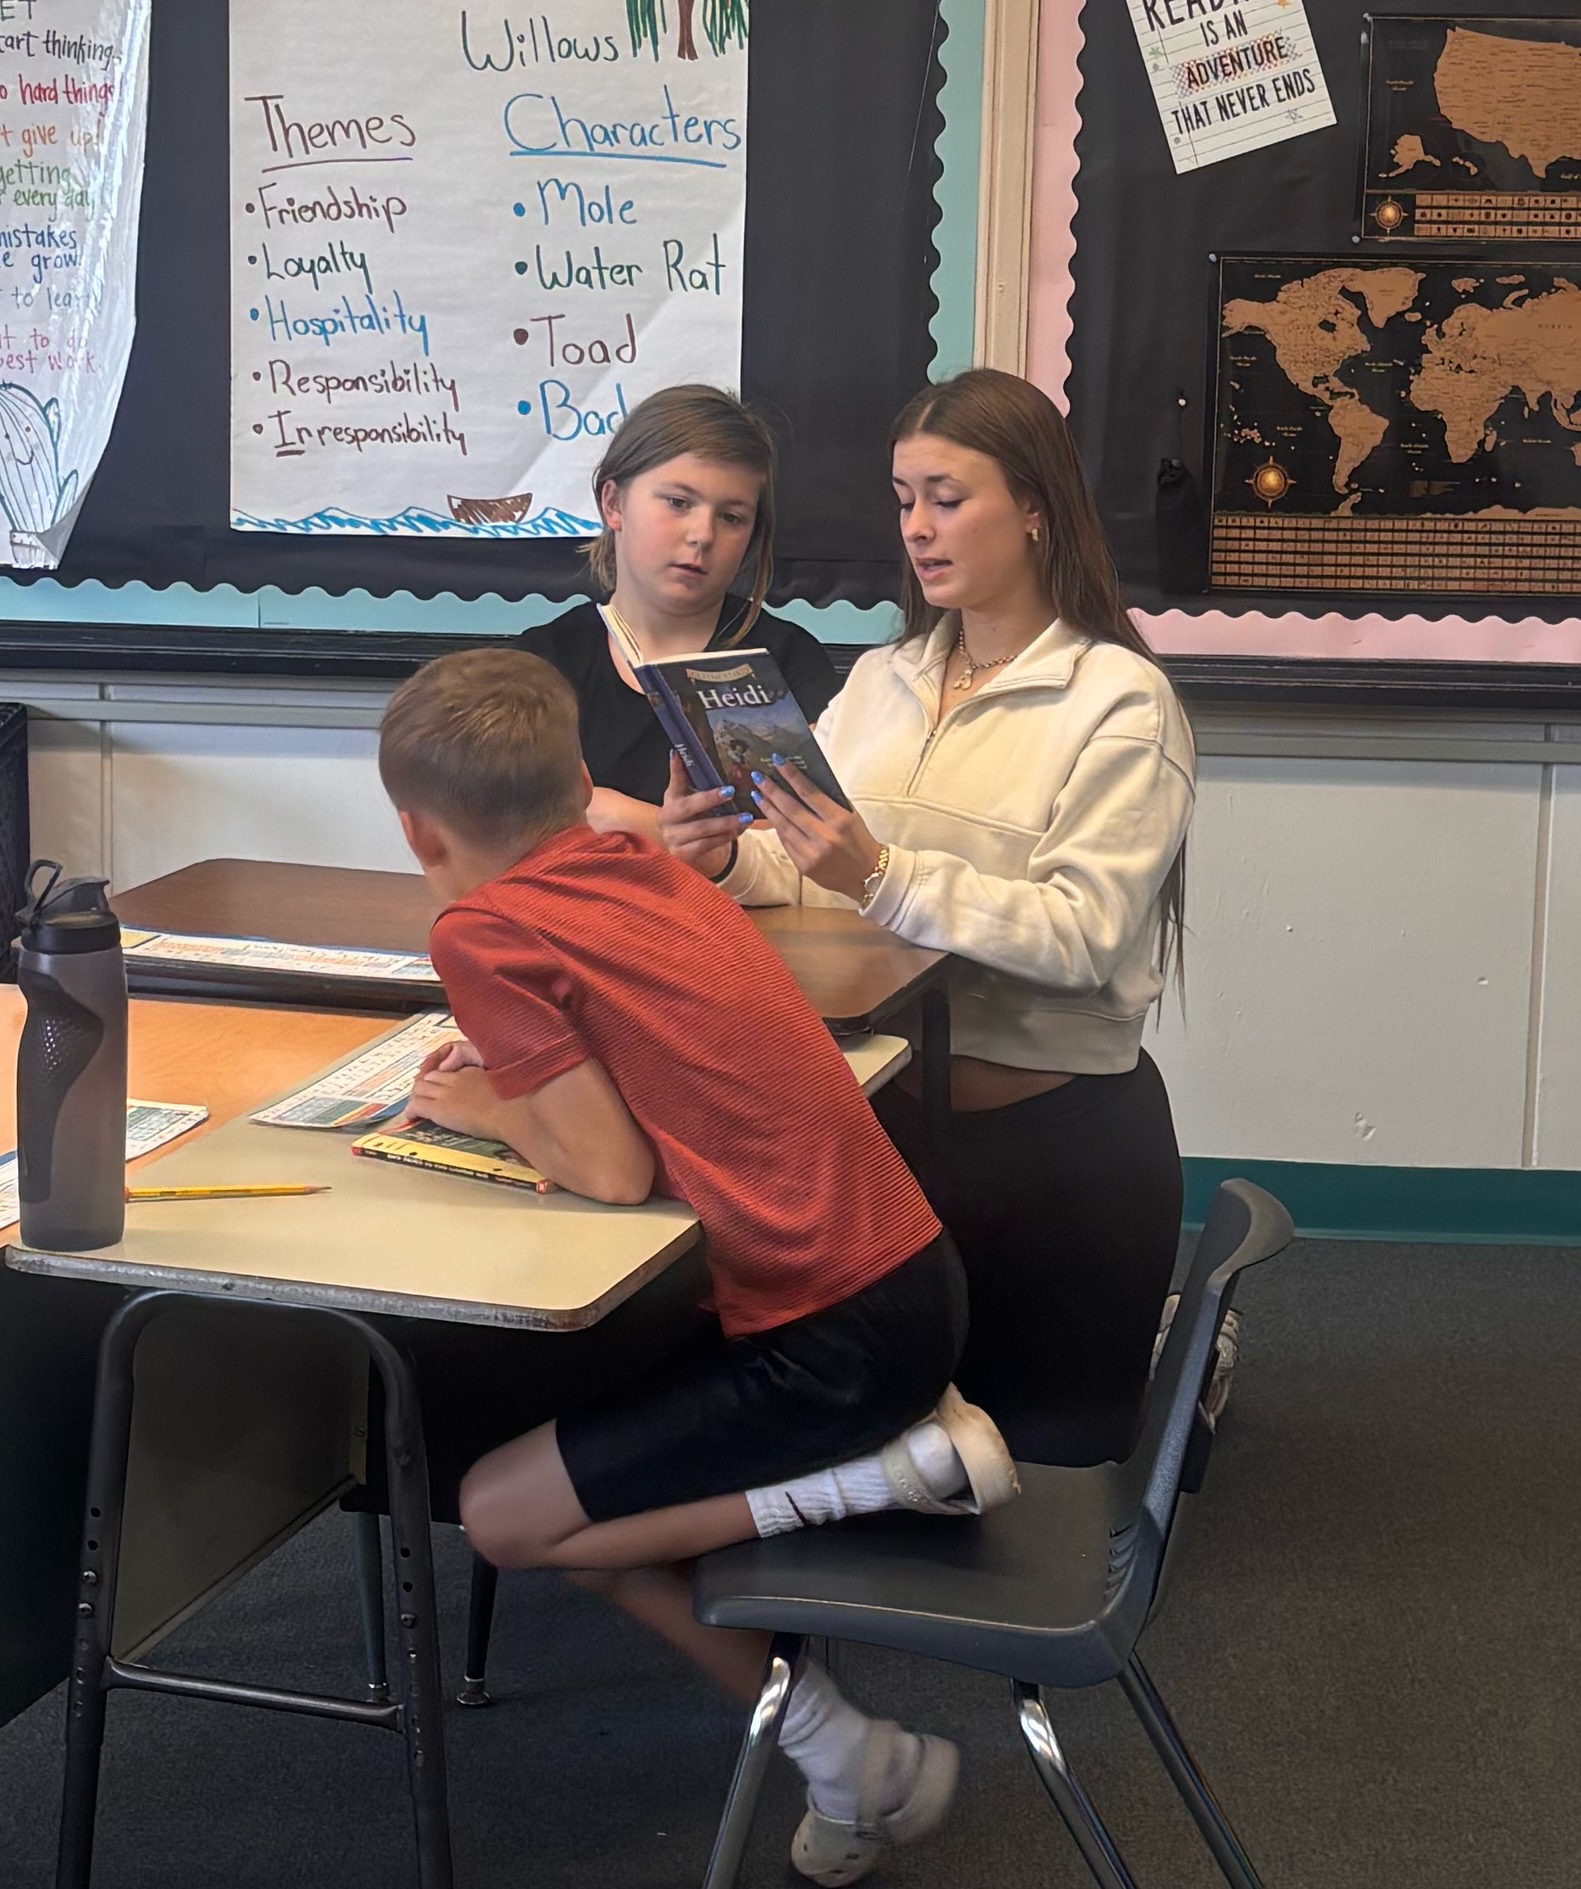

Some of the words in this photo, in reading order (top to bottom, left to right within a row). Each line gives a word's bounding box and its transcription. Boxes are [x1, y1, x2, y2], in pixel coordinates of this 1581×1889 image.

[461, 11, 620, 71] Willows
[1200, 20, 1219, 47] IS
[1224, 9, 1248, 40] AN
[1186, 36, 1288, 88] ADVENTURE
[18, 73, 58, 105] hard
[1171, 100, 1213, 134] THAT
[1215, 83, 1270, 121] NEVER
[1272, 68, 1316, 103] ENDS
[21, 122, 58, 158] give
[245, 94, 417, 159] Themes
[503, 85, 742, 152] Characters
[14, 188, 58, 223] every
[258, 183, 408, 234] Friendship
[537, 177, 638, 227] Mole
[263, 240, 372, 293] Loyalty
[535, 244, 643, 290] Water
[663, 233, 726, 295] Rat
[11, 286, 34, 310] to
[264, 289, 429, 357] Hospitality
[30, 328, 50, 351] to
[530, 313, 637, 367] Toad
[268, 359, 460, 412] Responsibility
[267, 410, 468, 457] Irresponsibility
[696, 684, 772, 709] Heidi
